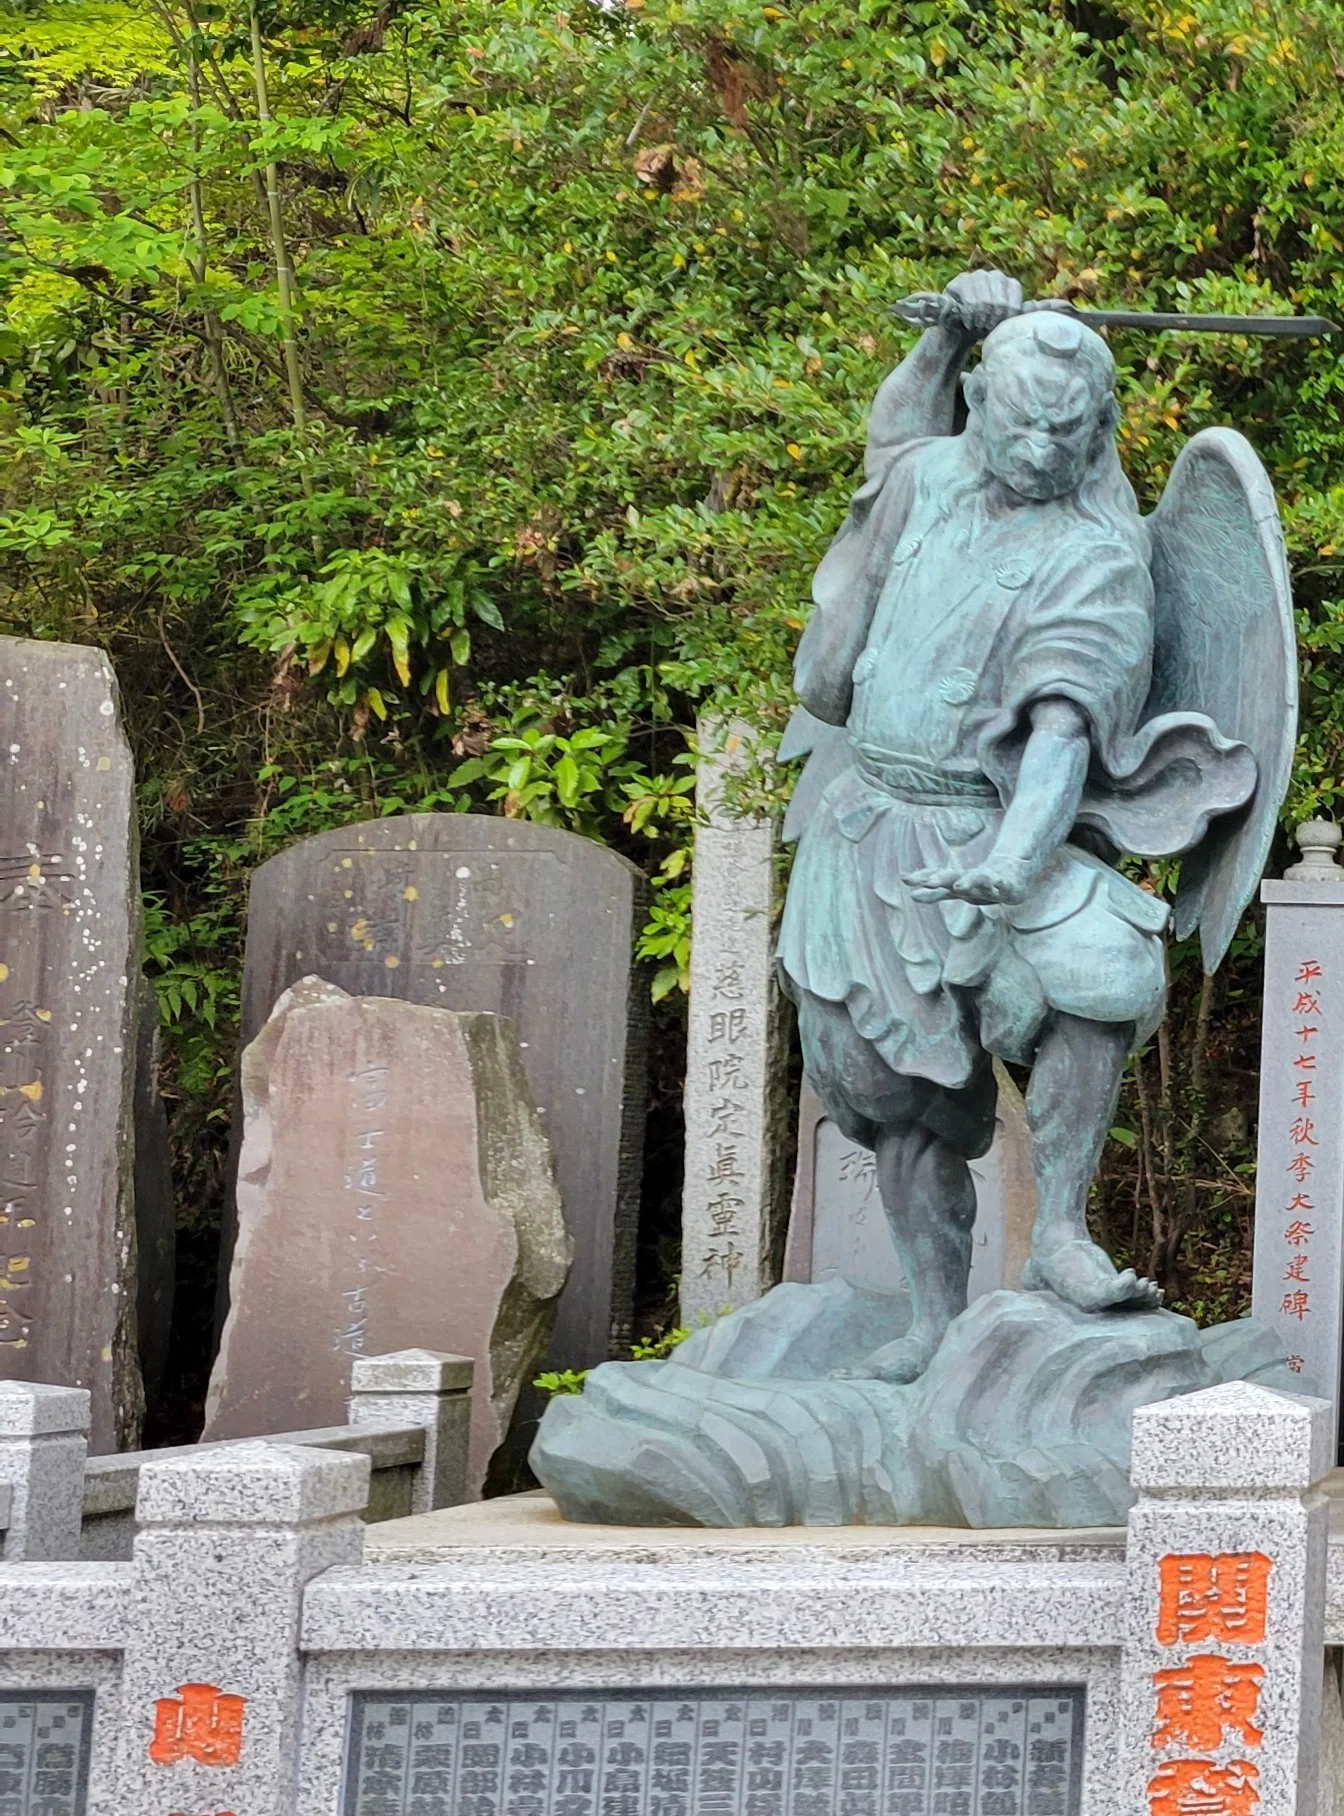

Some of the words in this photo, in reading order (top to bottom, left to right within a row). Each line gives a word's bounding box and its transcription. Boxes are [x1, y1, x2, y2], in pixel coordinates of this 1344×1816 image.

[1279, 960, 1323, 1321] 平成十七年秋季大祭建碑
